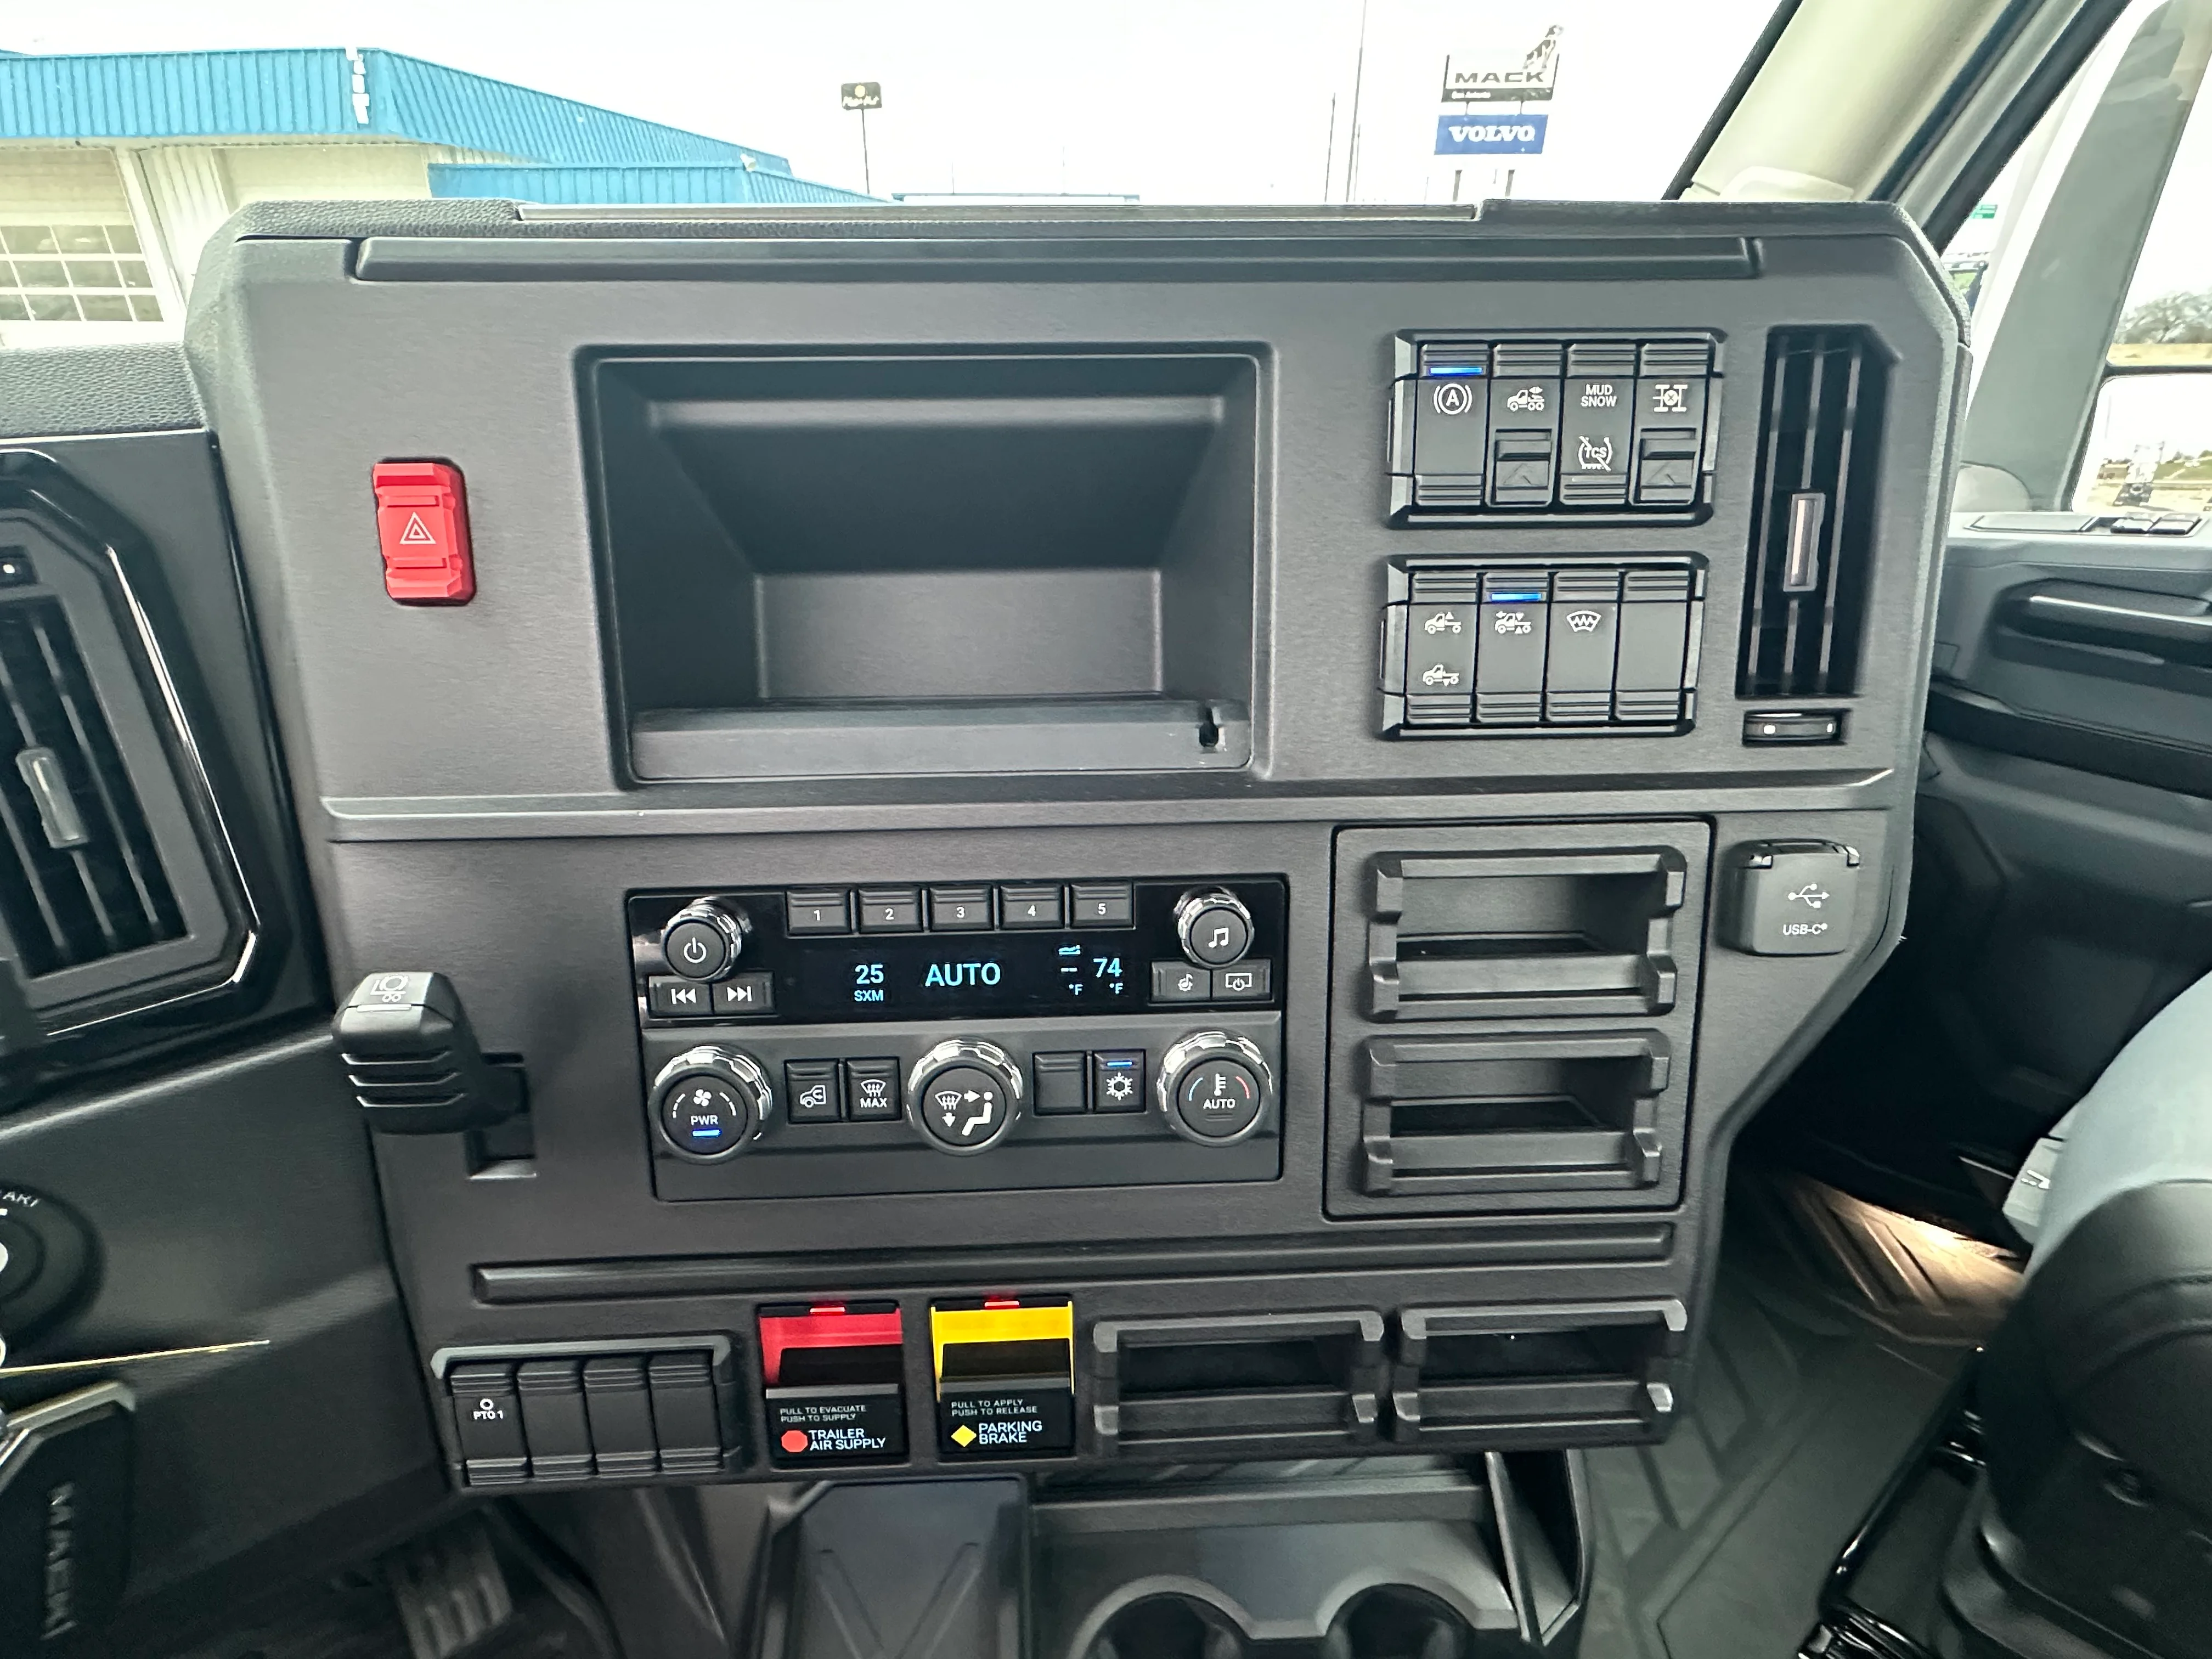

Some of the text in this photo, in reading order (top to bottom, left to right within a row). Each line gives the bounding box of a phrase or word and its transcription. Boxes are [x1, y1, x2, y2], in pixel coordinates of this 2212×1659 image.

[1455, 72, 1544, 83] MACK
[1448, 125, 1536, 142] VOLVO
[1585, 384, 1613, 395] MUD
[1581, 396, 1617, 407] SNOW
[1584, 447, 1607, 459] TCS
[885, 908, 894, 920] 2
[957, 906, 965, 918] 3
[1027, 905, 1036, 917] 4
[1098, 903, 1106, 915] 5
[814, 910, 821, 921] 1
[1093, 957, 1123, 978] 74
[855, 964, 884, 984] 25
[925, 962, 1001, 988] AUTO
[854, 990, 884, 1002] SXM
[860, 1097, 887, 1108] MAX
[1203, 1098, 1236, 1110] AUTO
[690, 1115, 719, 1125] PWR
[820, 1404, 867, 1413] EVACUATE
[994, 1398, 1024, 1407] APPLY
[473, 1410, 503, 1420] PTO 1
[823, 1413, 856, 1421] SUPPLY
[952, 1408, 978, 1417] PUSH
[996, 1406, 1038, 1414] RELEASE
[979, 1420, 1042, 1434] PARKING
[809, 1428, 865, 1440] TRAILER
[979, 1431, 1028, 1444] BRAKE
[810, 1437, 886, 1451] AIR SUPPLY
